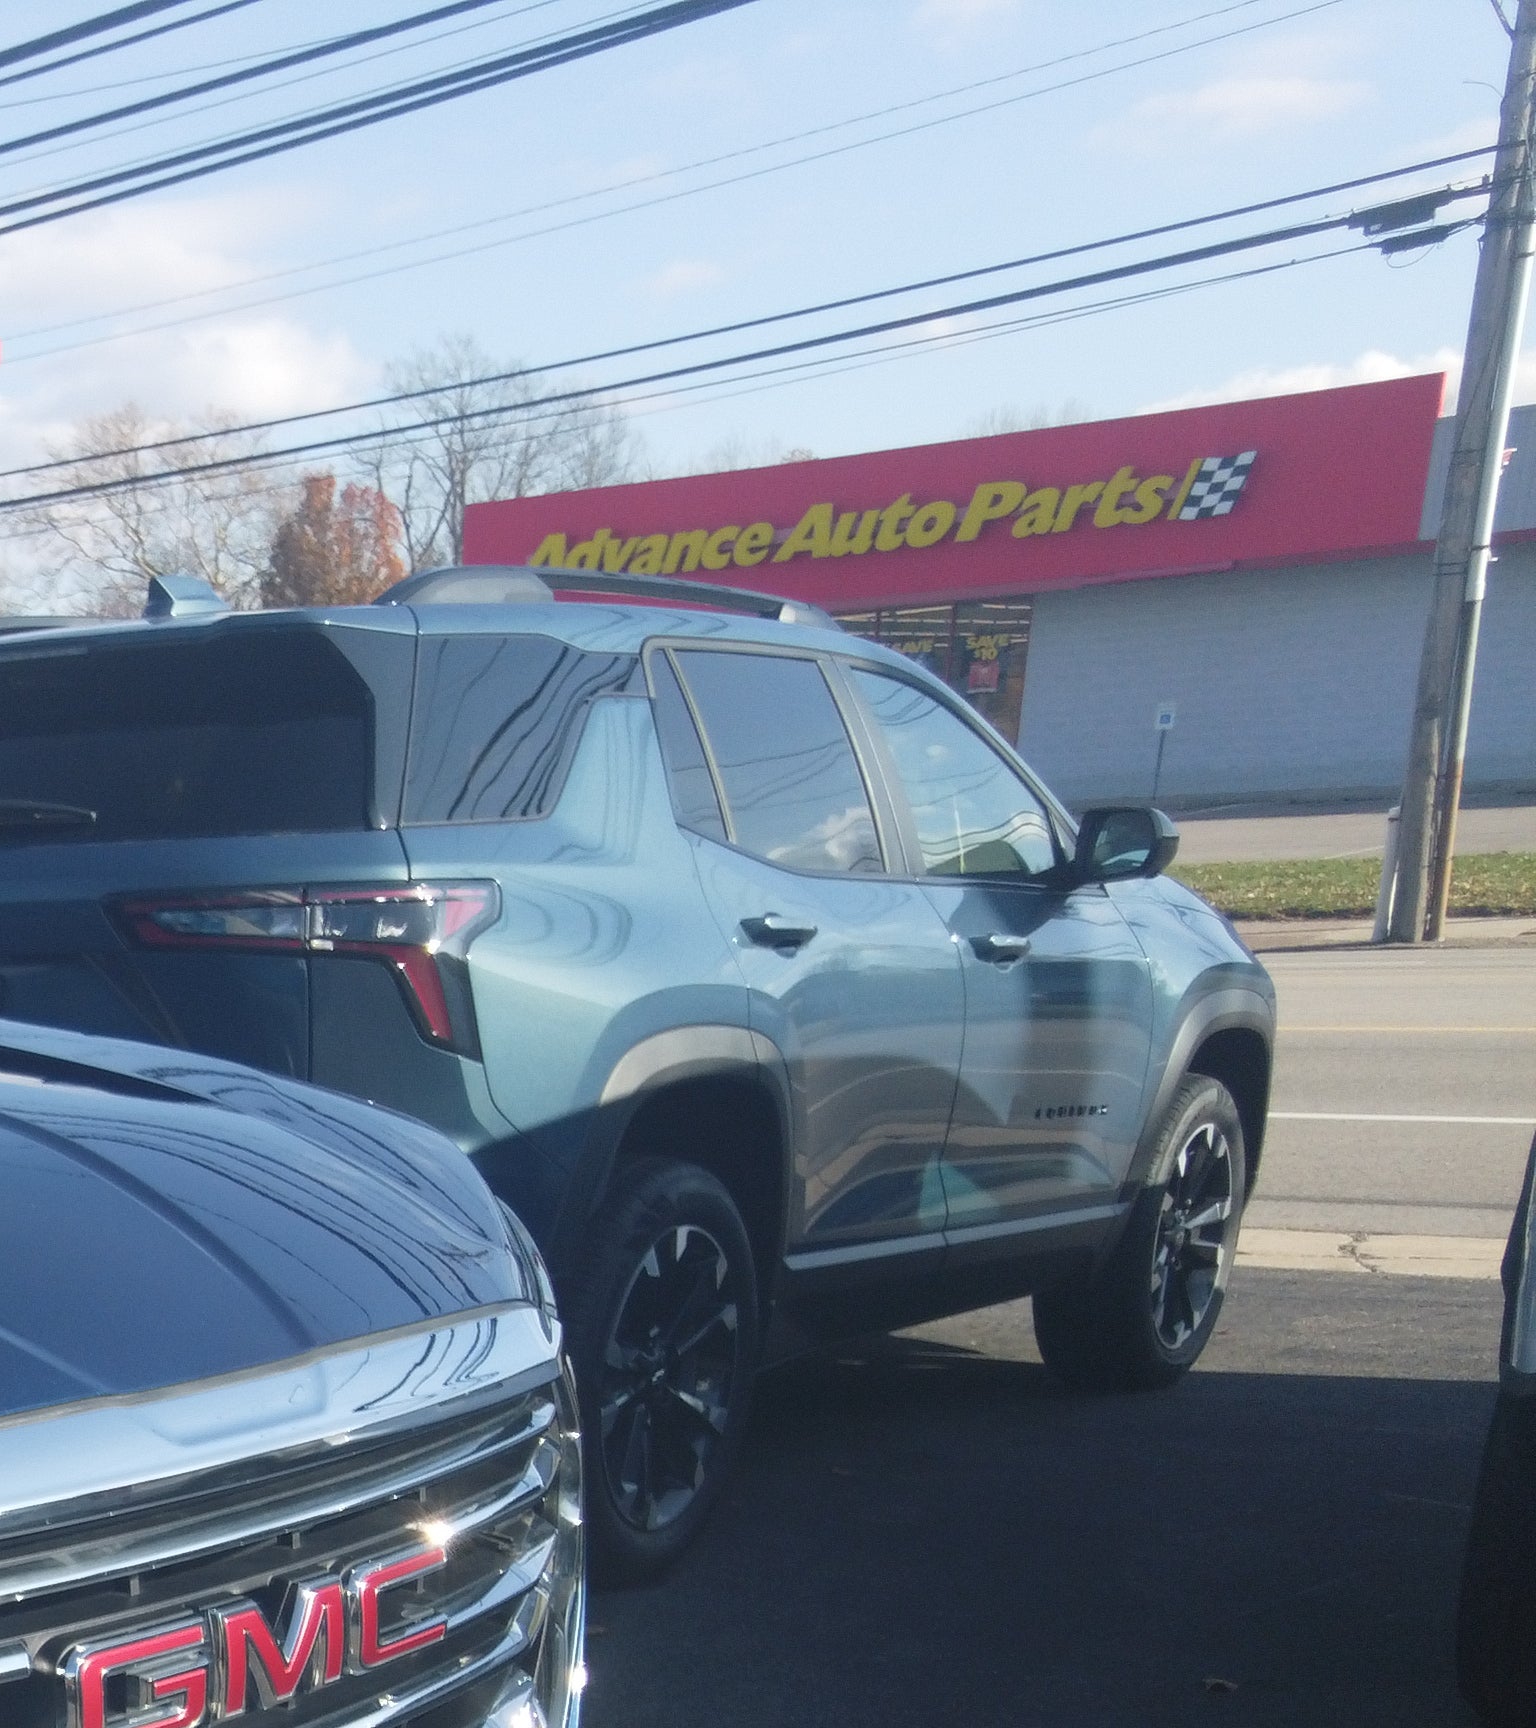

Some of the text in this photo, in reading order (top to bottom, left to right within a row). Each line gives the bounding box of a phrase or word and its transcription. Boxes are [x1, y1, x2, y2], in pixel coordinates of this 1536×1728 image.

[531, 465, 1175, 573] Advance Auto Parts
[966, 634, 1009, 651] SAVE
